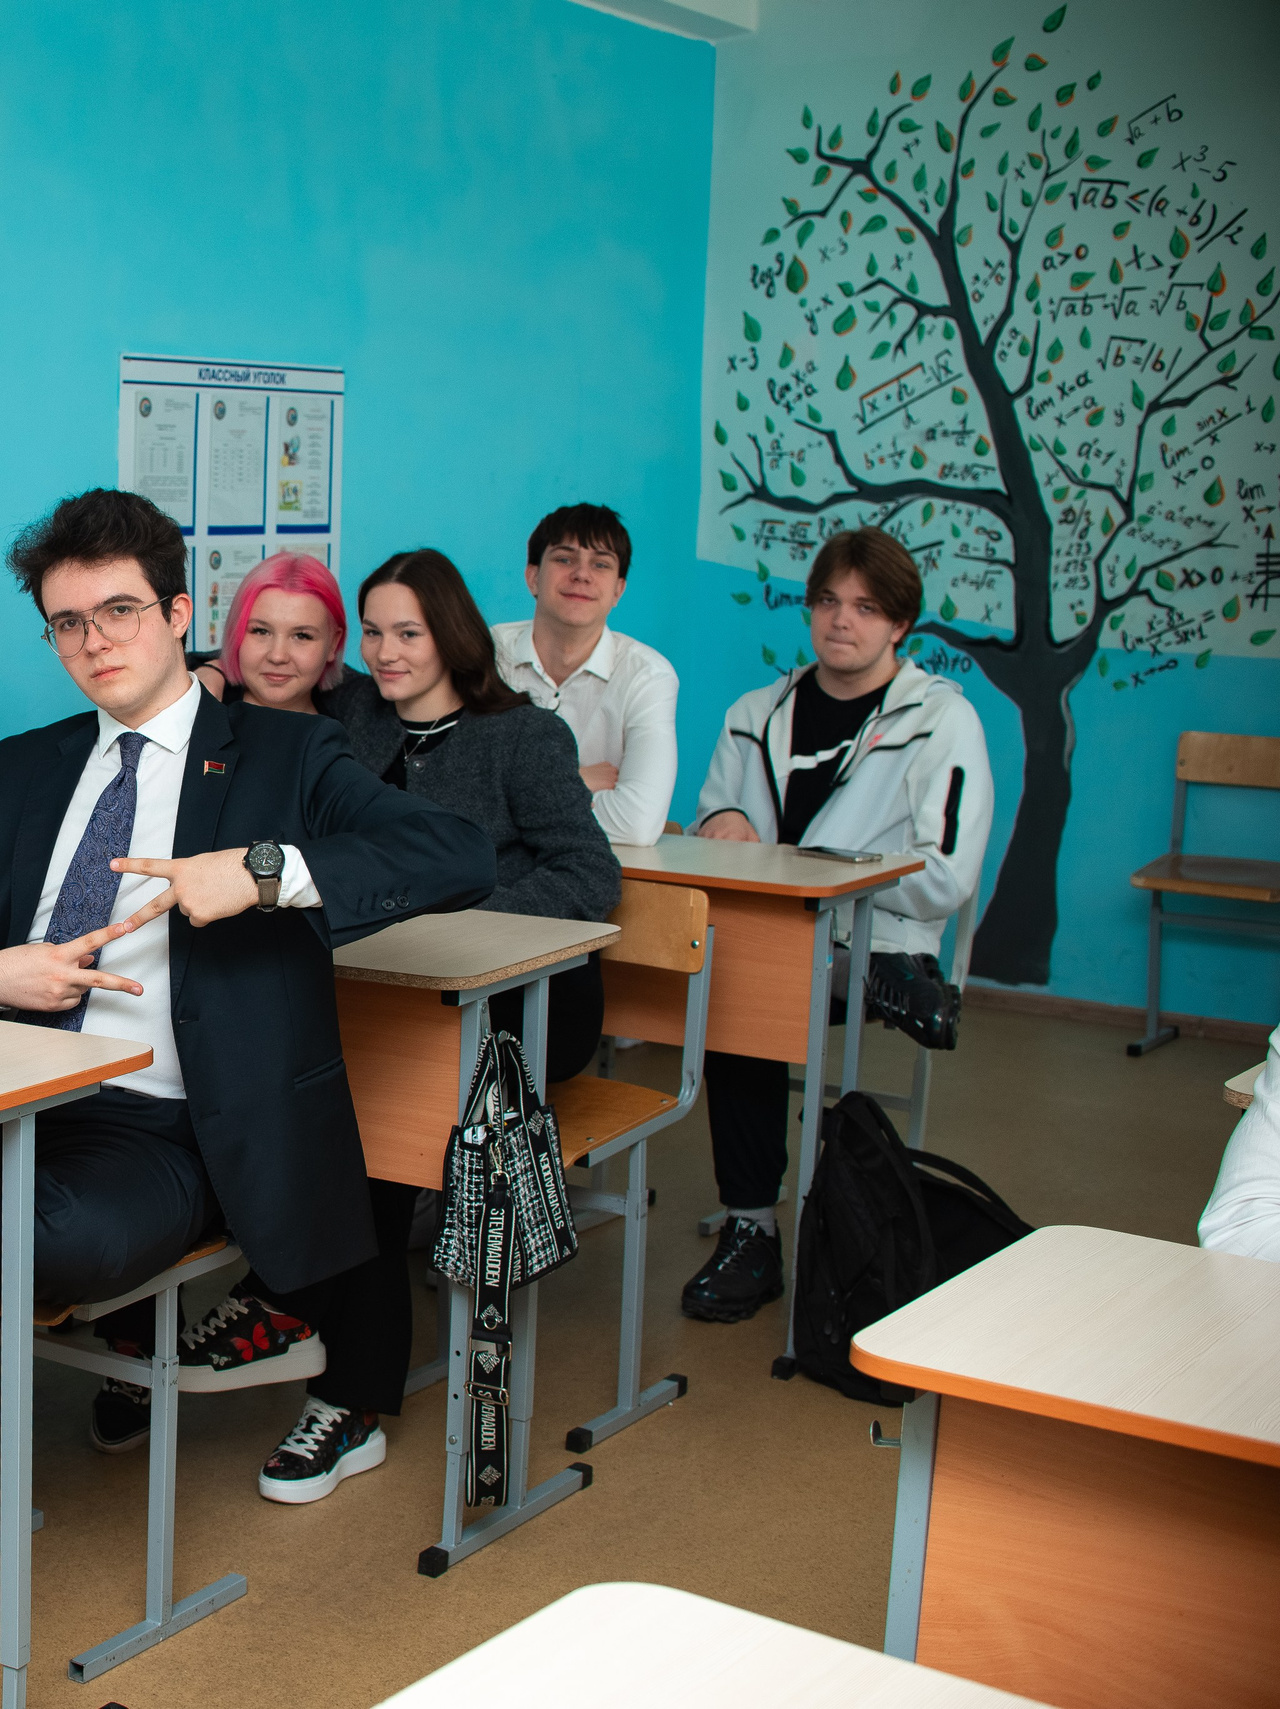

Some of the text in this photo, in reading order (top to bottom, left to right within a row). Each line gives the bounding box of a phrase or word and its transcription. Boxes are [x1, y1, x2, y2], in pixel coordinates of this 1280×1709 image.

[197, 367, 287, 386] КЛАССНЫЙ УГОЛОК
[537, 1152, 566, 1231] STEVEMADDEN
[484, 1206, 506, 1288] STEVEMADDEN
